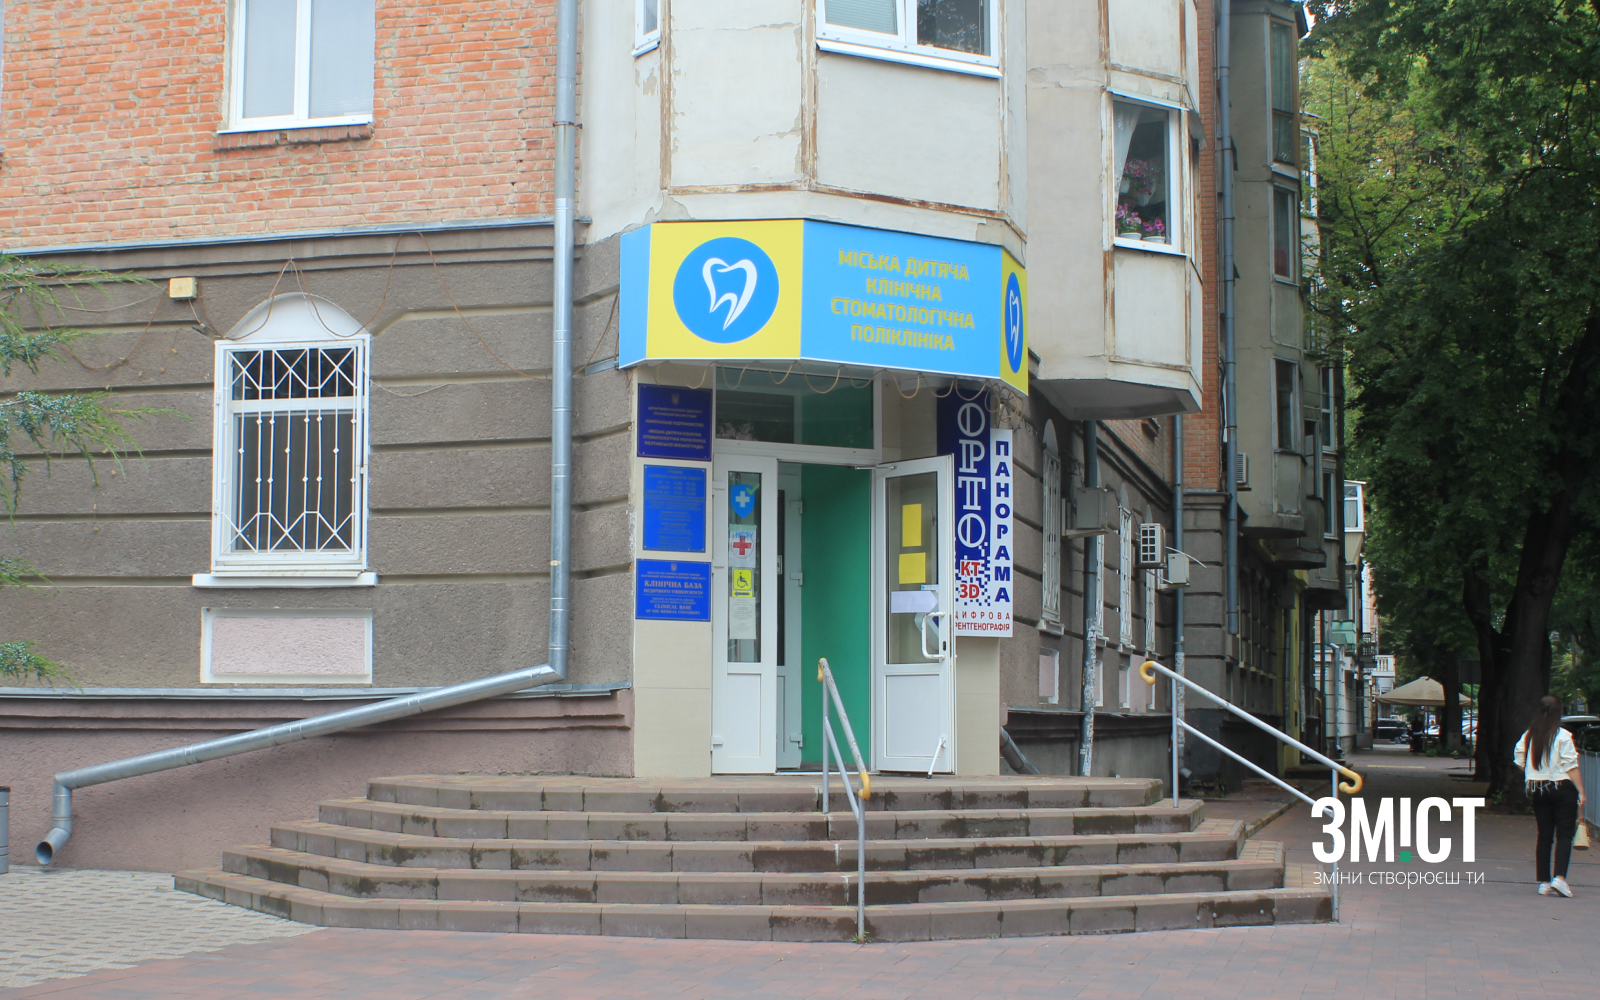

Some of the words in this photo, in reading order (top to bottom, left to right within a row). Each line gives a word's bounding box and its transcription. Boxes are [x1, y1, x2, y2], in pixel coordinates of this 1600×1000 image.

[839, 249, 900, 272] МІСЬКА
[905, 258, 969, 280] ДИТЯЧА
[866, 277, 942, 301] КЛІНІЧНА
[831, 297, 975, 329] СТОМАТОЛОГІЧНА
[851, 324, 955, 351] ПОЛІКЛІНІКА
[957, 402, 986, 548] ОРТО
[994, 440, 1011, 603] ПАНОРАМА
[961, 561, 980, 576] КТ
[644, 580, 682, 588] КЛІНІЧНА
[959, 583, 980, 599] 3D
